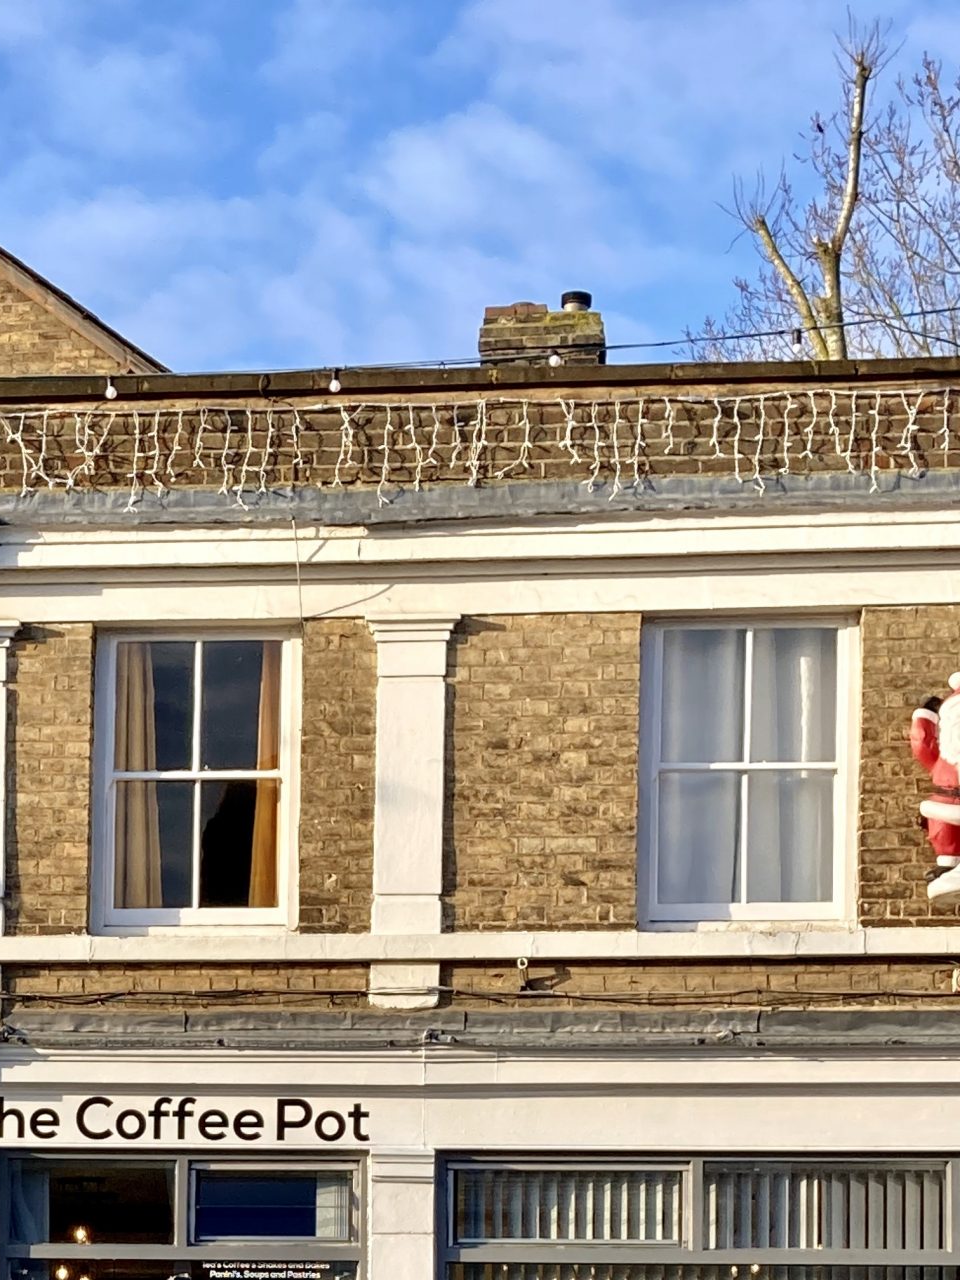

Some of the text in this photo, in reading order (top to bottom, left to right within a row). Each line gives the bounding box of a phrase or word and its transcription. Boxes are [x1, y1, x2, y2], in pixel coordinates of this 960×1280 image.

[76, 1096, 264, 1141] Coffee
[276, 1098, 370, 1142] Pot
[243, 1270, 270, 1280] Soups
[270, 1271, 287, 1279] and
[287, 1271, 321, 1279] Pastries
